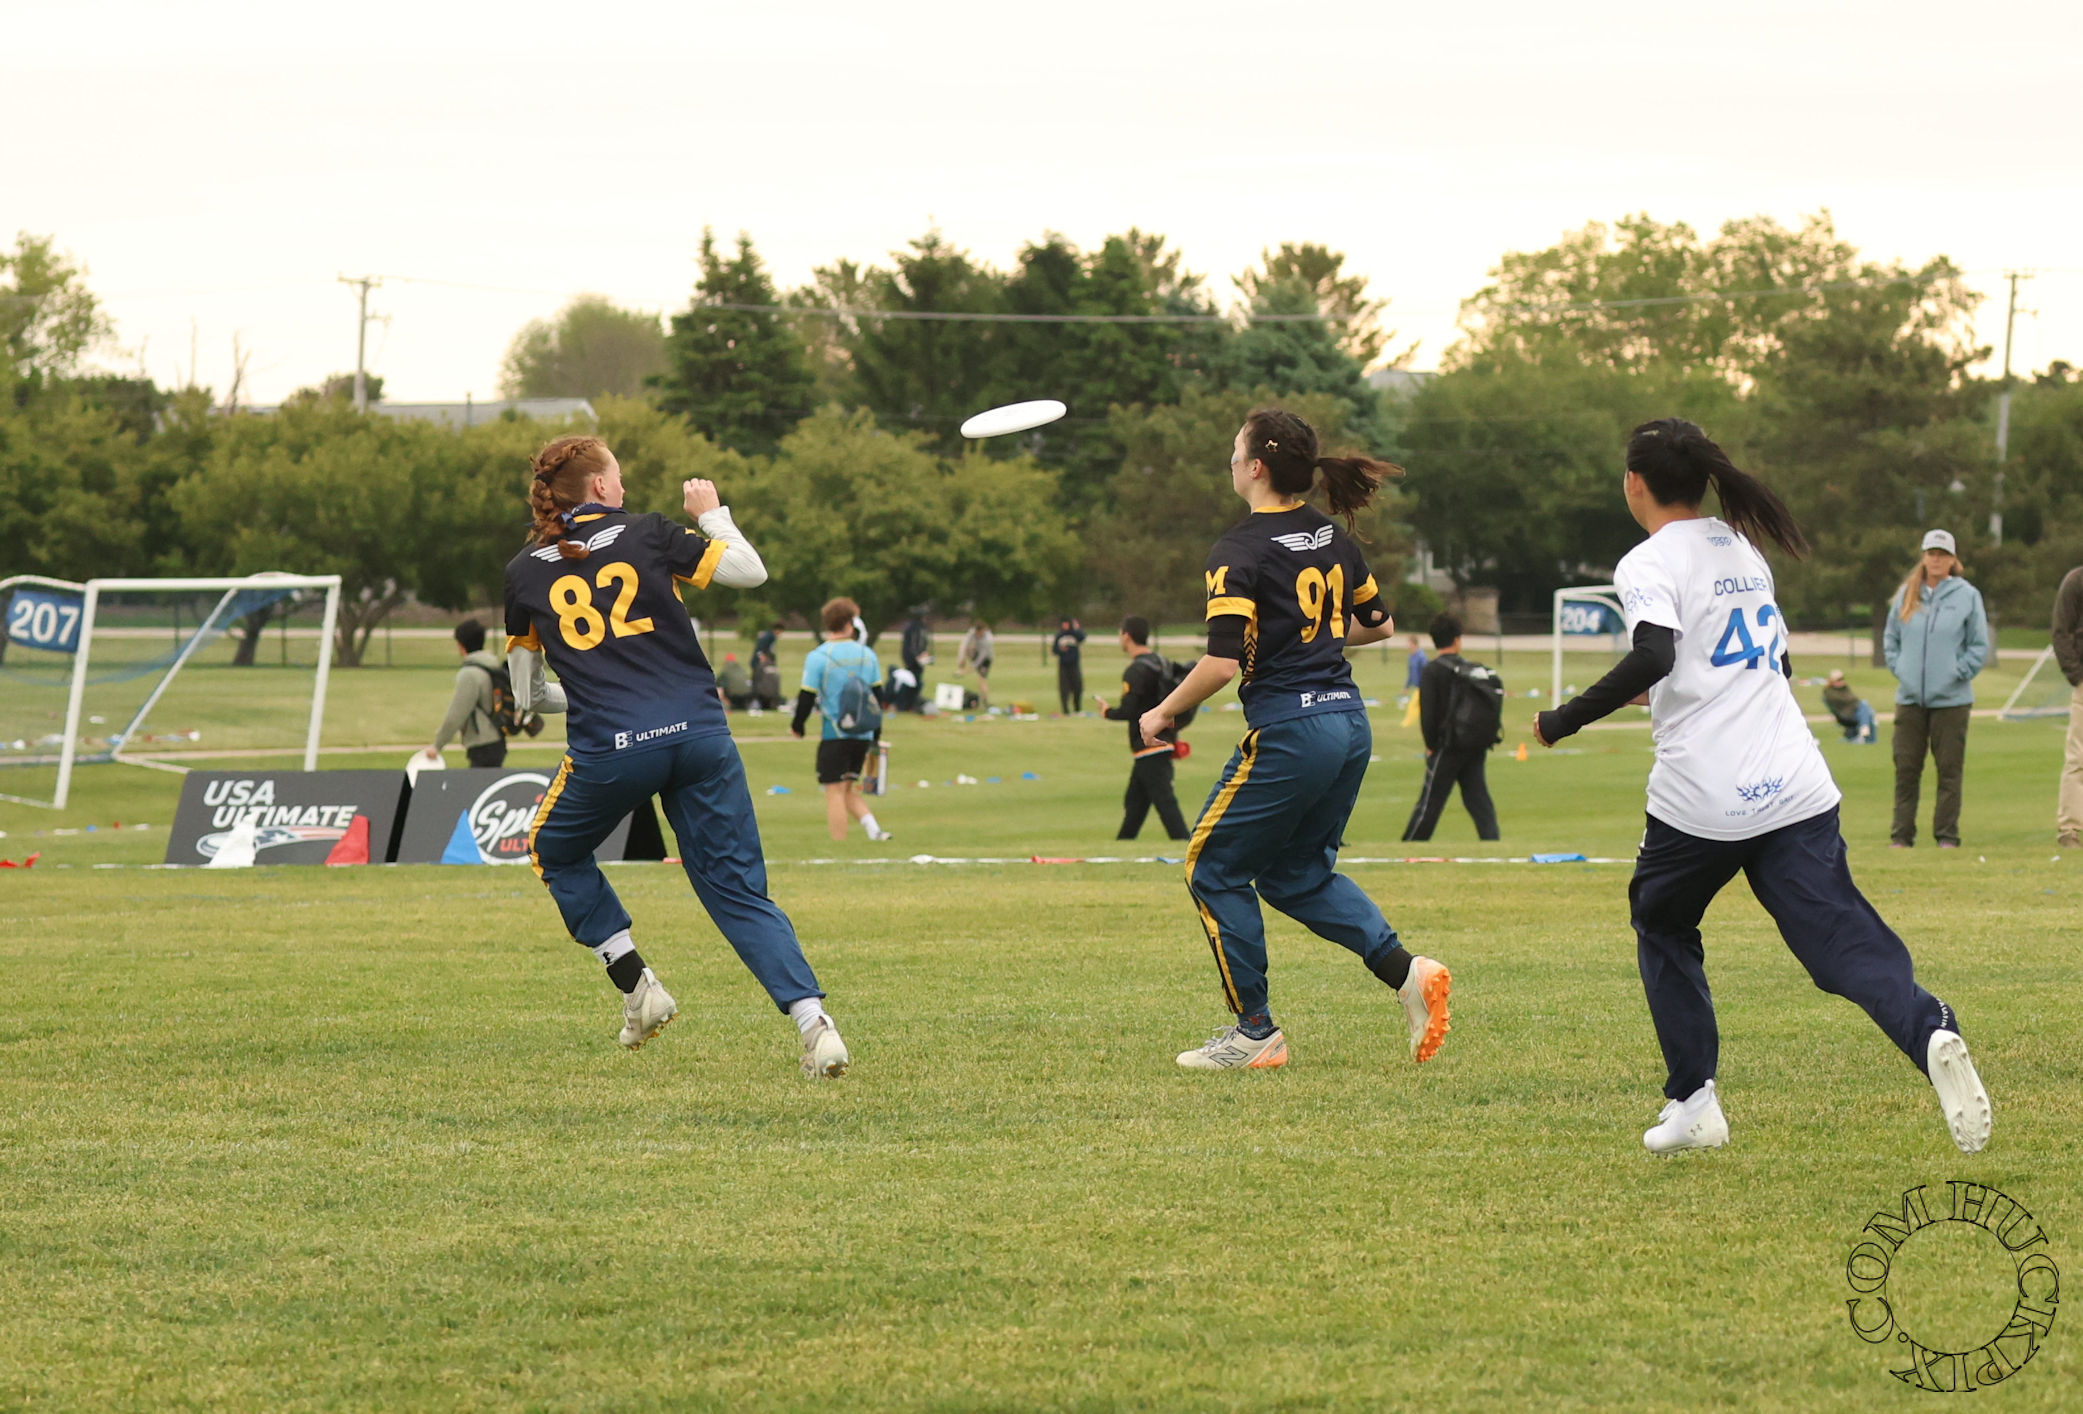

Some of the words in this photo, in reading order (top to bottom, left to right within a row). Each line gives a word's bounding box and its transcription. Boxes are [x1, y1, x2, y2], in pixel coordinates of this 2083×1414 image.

[1205, 566, 1229, 600] M
[549, 561, 655, 651] 82
[1296, 563, 1345, 643] 91
[1561, 606, 1600, 633] 204
[9, 599, 80, 645] 207
[1711, 604, 1780, 674] 42
[636, 721, 688, 742] ULTIMATE
[203, 780, 275, 806] USA
[212, 805, 358, 828] ULTIMATE
